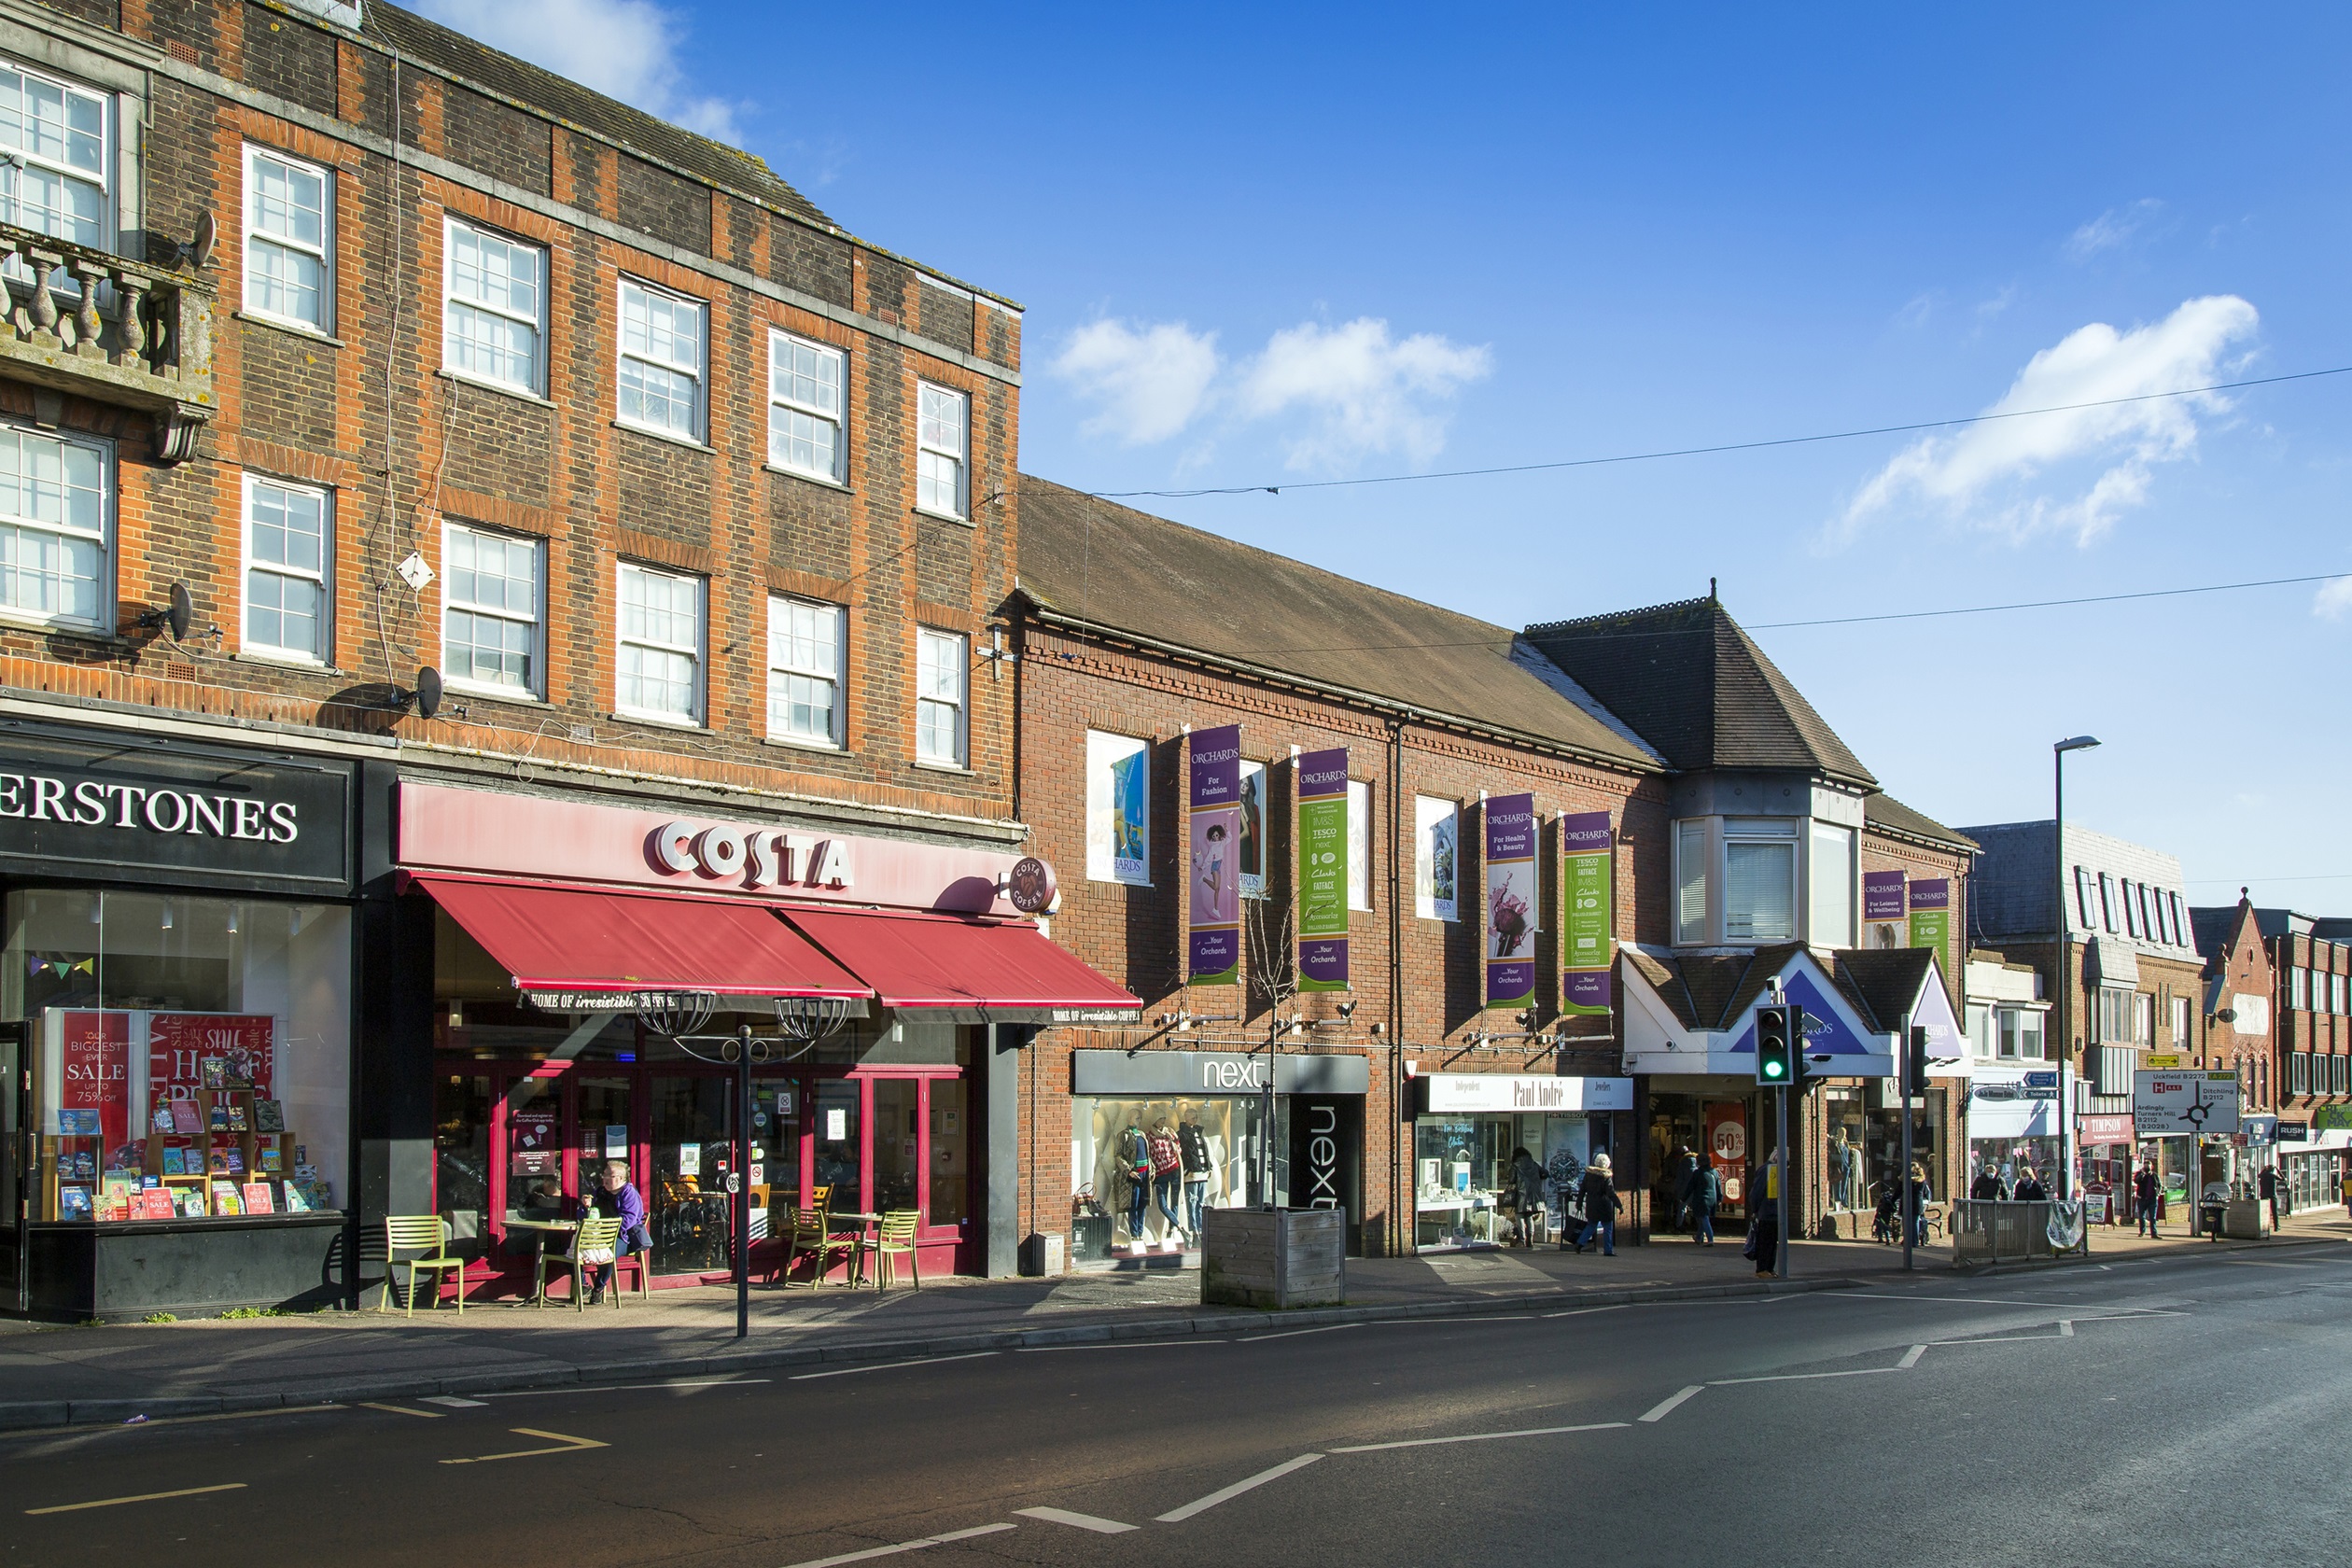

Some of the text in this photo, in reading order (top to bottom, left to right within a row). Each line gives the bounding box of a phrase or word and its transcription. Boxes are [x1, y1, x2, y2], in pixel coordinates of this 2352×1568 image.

[1191, 748, 1239, 764] ORCHARDS
[1300, 769, 1347, 784] ORCHARDS
[1201, 787, 1227, 796] Fashion
[0, 773, 300, 844] ERSTONES
[1487, 812, 1532, 825] ORCHARDS
[1312, 828, 1337, 836] TESCO
[1565, 829, 1609, 841] ORCHARDS
[1505, 834, 1526, 843] Health
[1315, 841, 1331, 849] next
[658, 820, 855, 888] COSTA
[1015, 862, 1041, 877] COSTA
[1310, 868, 1337, 878] Clarks
[1577, 868, 1597, 876] FATFACE
[1313, 880, 1335, 890] FATFACE
[1865, 884, 1903, 893] ORCHARDS
[1575, 888, 1600, 897] Clarks
[1911, 891, 1948, 901] ORCHARDS
[1014, 889, 1043, 907] COFFEE
[1309, 912, 1338, 921] Accessorize
[1200, 946, 1227, 956] Orchards
[1310, 955, 1337, 964] Orchards
[531, 994, 559, 1008] HOME
[560, 994, 574, 1008] OF
[575, 995, 637, 1008] irresistible
[1052, 1010, 1071, 1021] HOME
[1071, 1010, 1080, 1021] OF
[1081, 1011, 1118, 1021] irresistible
[87, 1031, 107, 1040] OUR
[205, 1029, 243, 1049] SALE
[71, 1042, 120, 1052] BIGGEST
[67, 1063, 125, 1080] SALE
[1202, 1060, 1266, 1089] next
[1594, 1081, 1611, 1091] Jewellers
[2155, 1084, 2163, 1093] H
[77, 1092, 103, 1102] 75%
[1514, 1080, 1563, 1107] Paul André
[2092, 1118, 2121, 1133] TIMPSON
[2327, 1119, 2352, 1127] MAY
[1716, 1133, 1743, 1151] 50%
[1310, 1106, 1337, 1211] next
